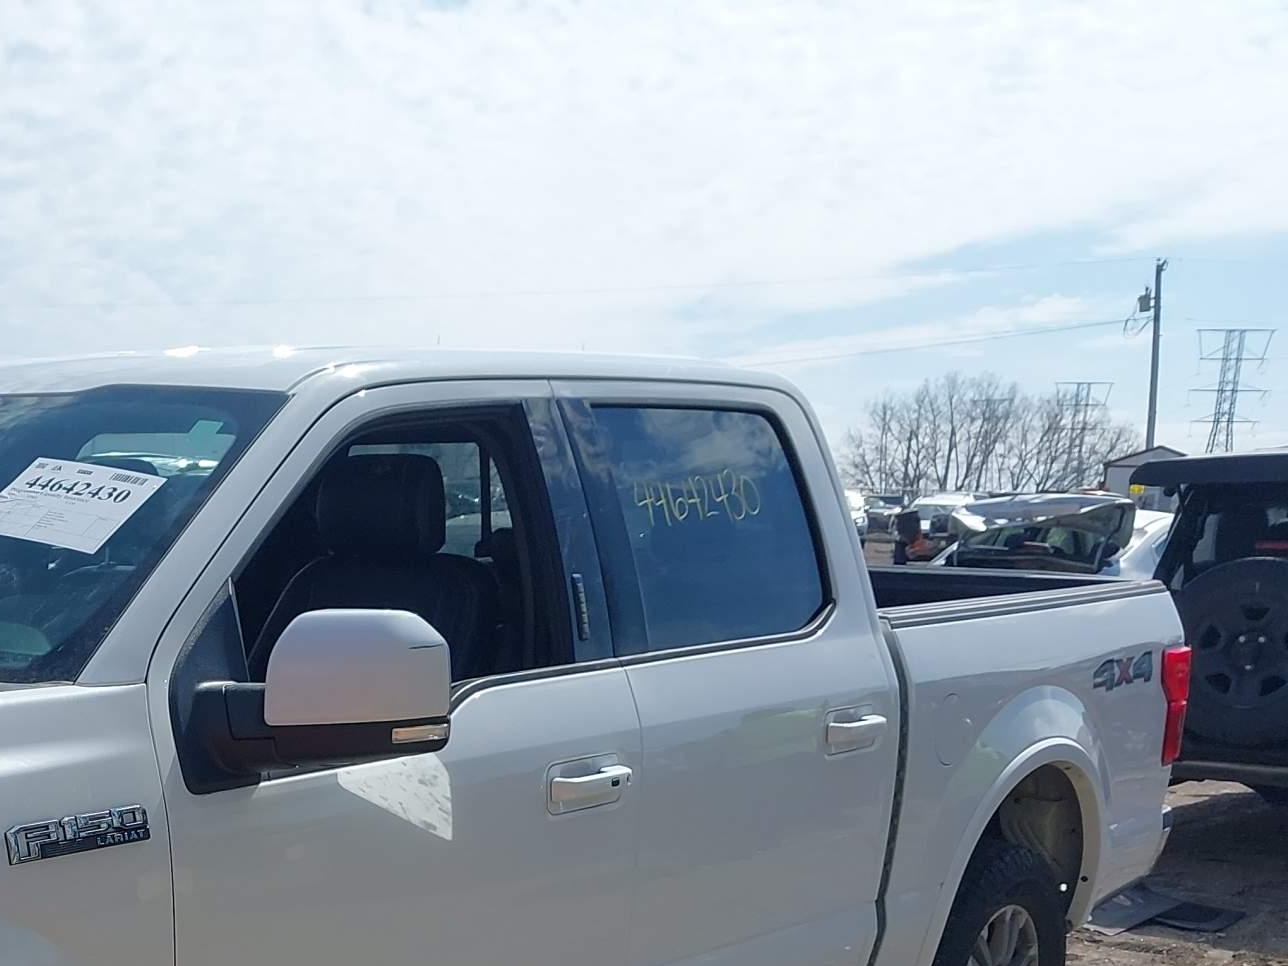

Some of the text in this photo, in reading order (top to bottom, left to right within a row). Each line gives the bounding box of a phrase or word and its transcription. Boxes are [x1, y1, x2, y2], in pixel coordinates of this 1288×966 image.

[25, 475, 131, 504] 44642430
[633, 468, 761, 527] 44642430
[96, 828, 146, 847] LARIAT
